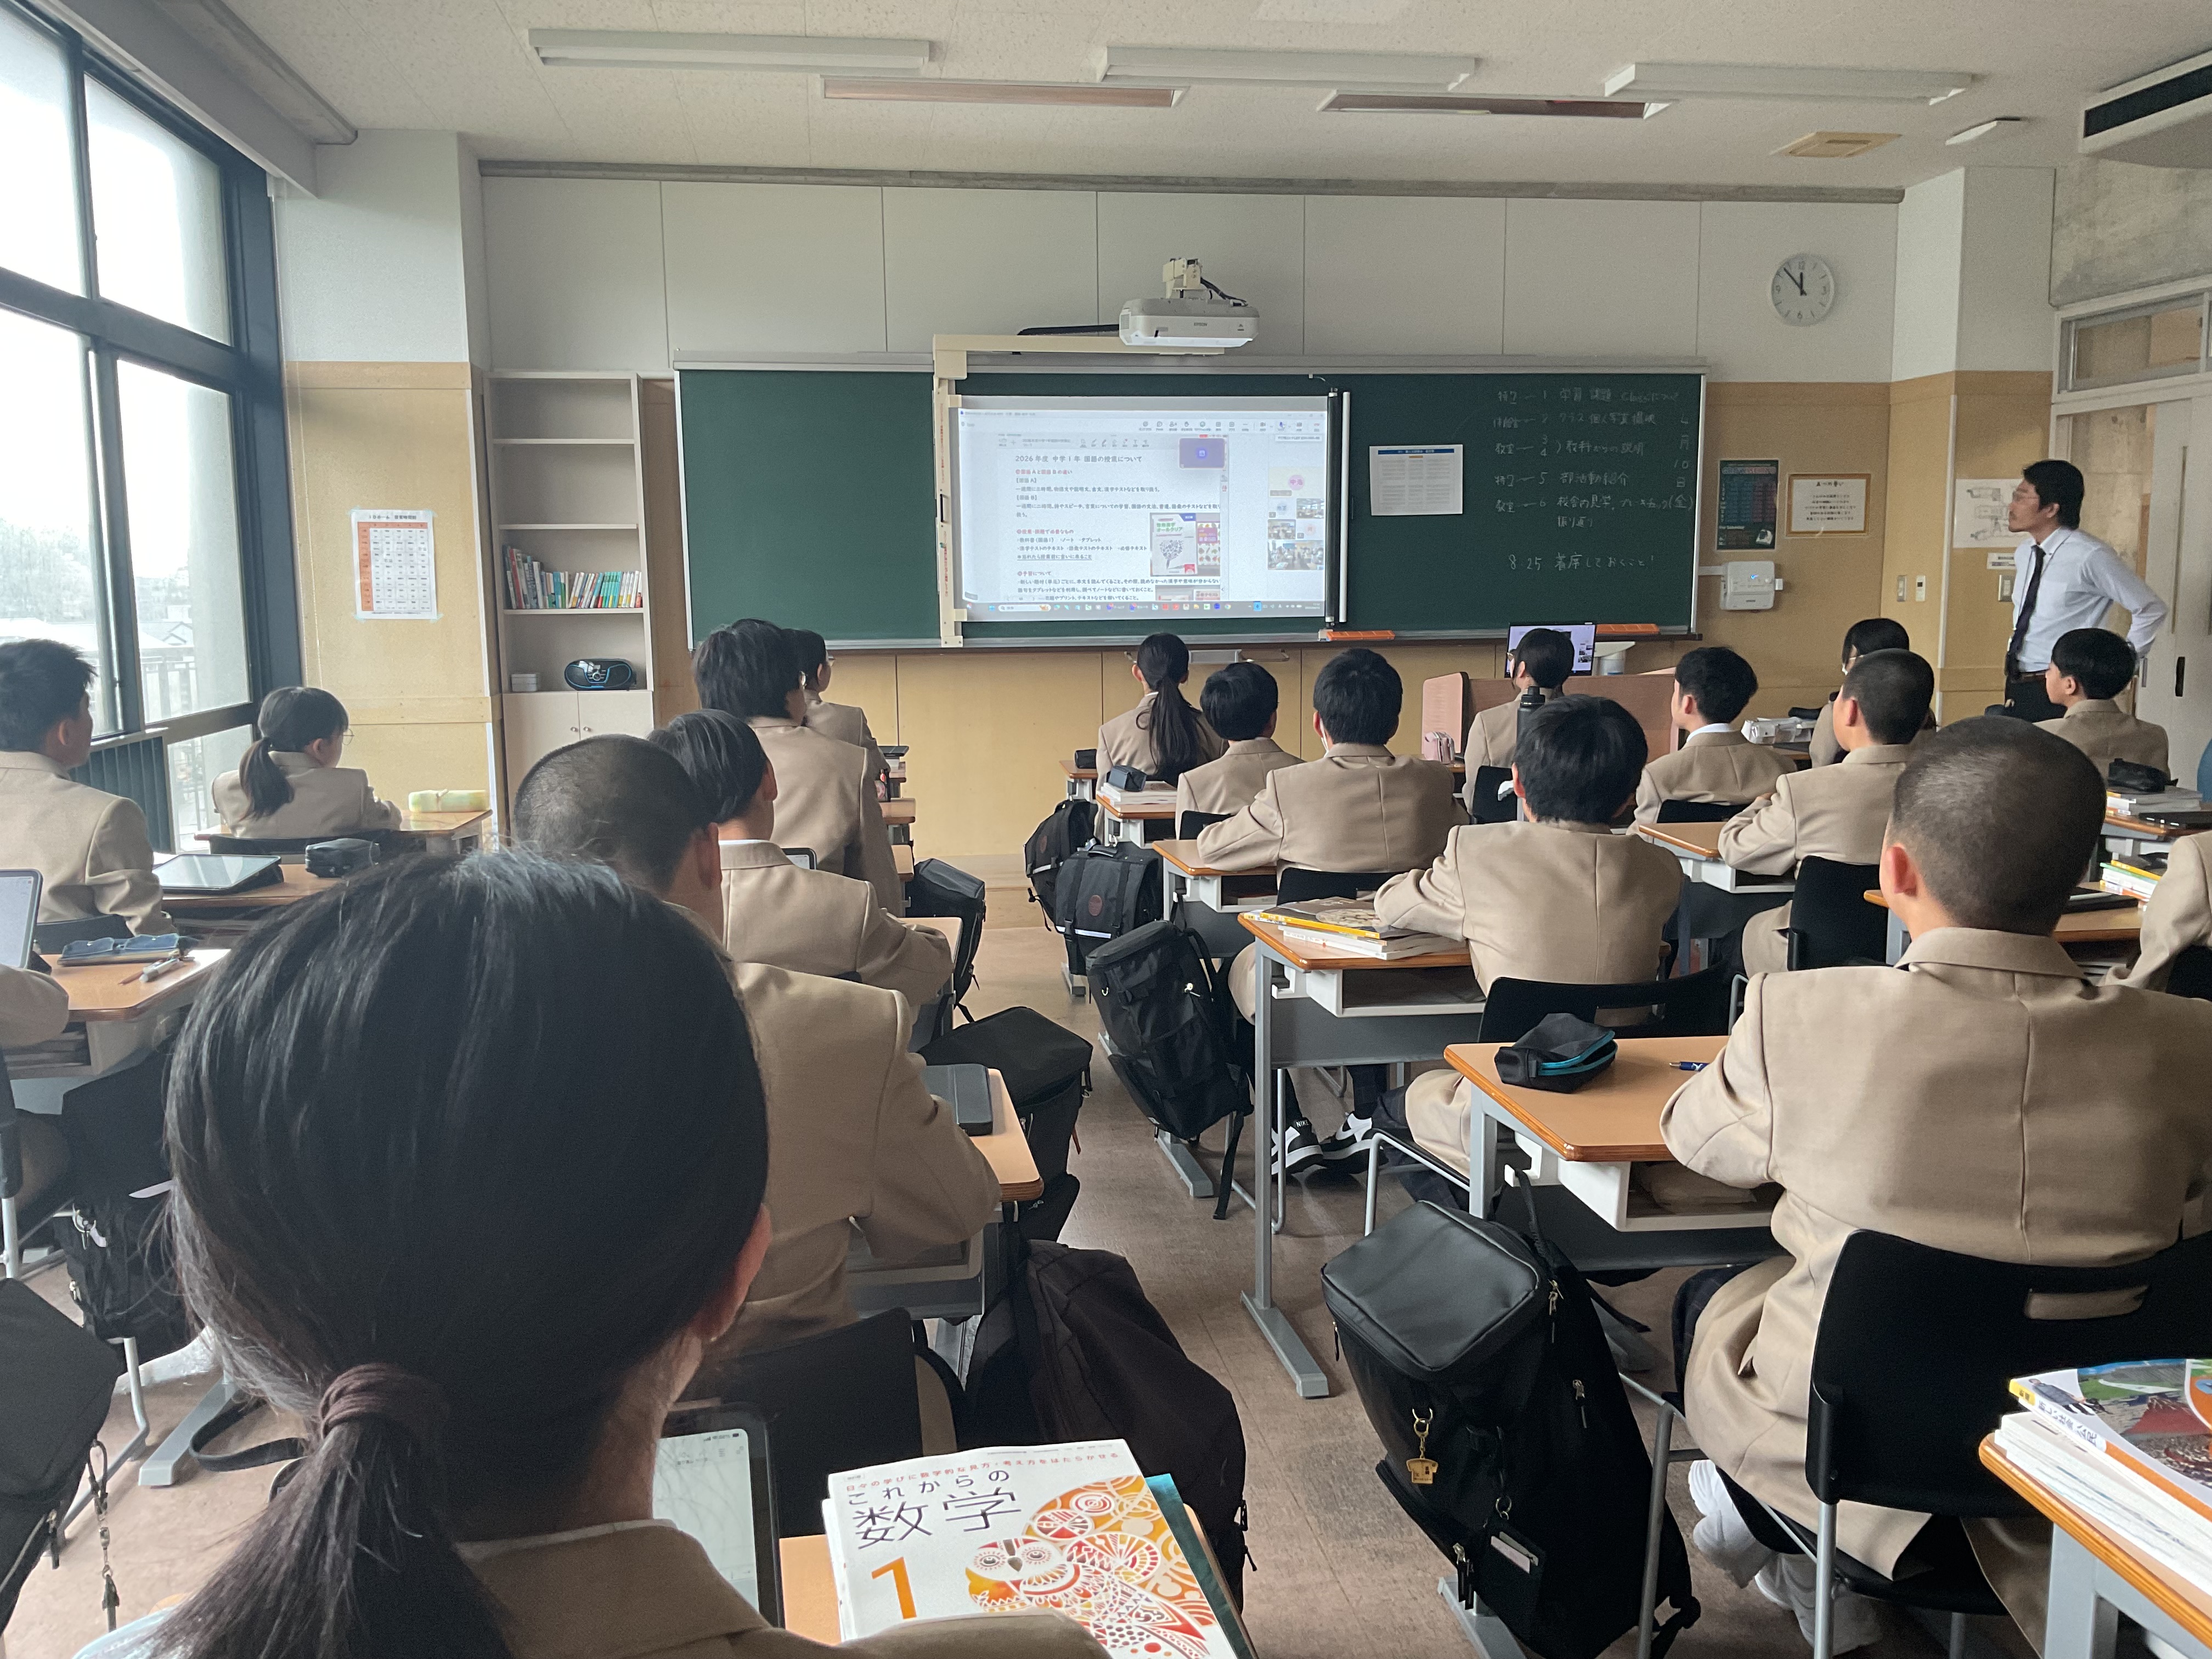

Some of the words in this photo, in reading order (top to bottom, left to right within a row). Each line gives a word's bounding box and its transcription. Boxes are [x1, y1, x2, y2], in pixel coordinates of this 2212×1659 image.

[846, 1452, 1119, 1492] 日々の学びに数学的な見方・考え方をはたらかせる
[848, 1469, 1010, 1505] これからの
[853, 1486, 1022, 1550] 数学
[871, 1556, 917, 1620] 1
